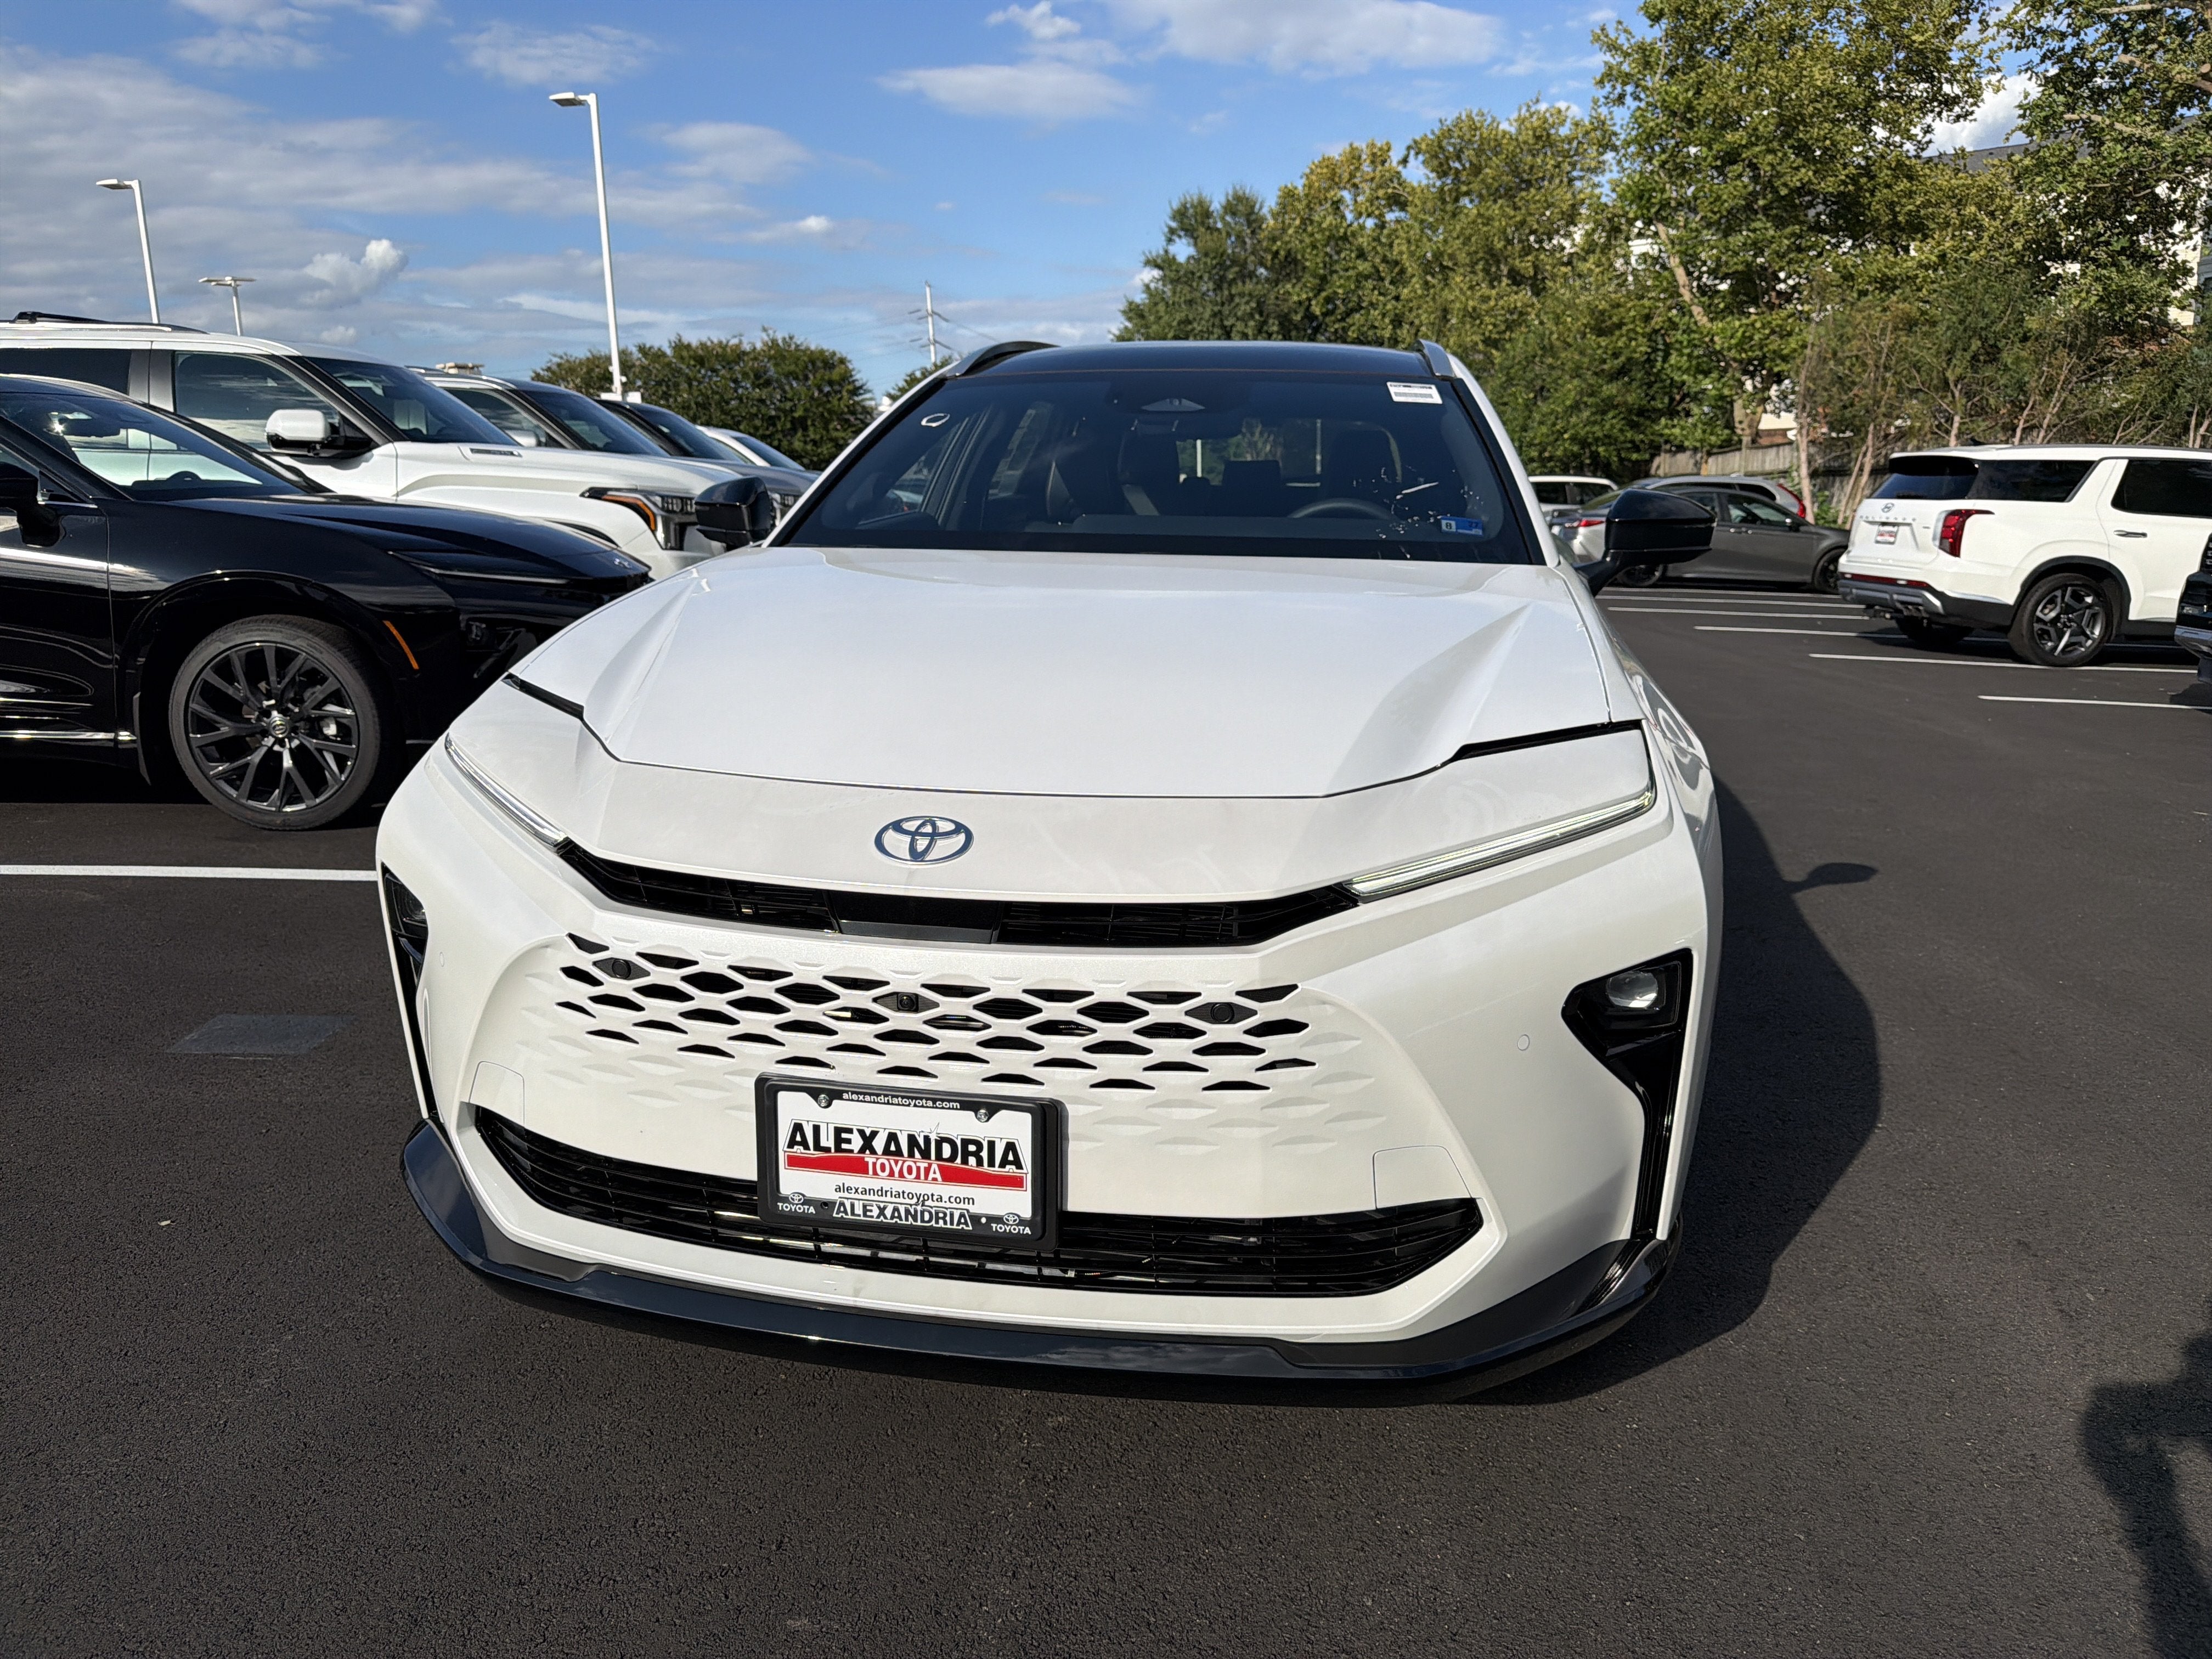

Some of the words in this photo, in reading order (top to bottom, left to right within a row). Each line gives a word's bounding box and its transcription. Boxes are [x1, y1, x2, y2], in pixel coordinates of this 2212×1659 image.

[842, 1092, 960, 1109] alexandriatoyota.com
[786, 1121, 1024, 1171] ALEXANDRIA
[865, 1157, 943, 1182] TOYOTA
[834, 1182, 975, 1206] alexandriatoyota.com
[777, 1202, 816, 1214] TOYOTA
[833, 1198, 973, 1230] ALEXANDRIA
[991, 1223, 1032, 1235] TOYOTA
